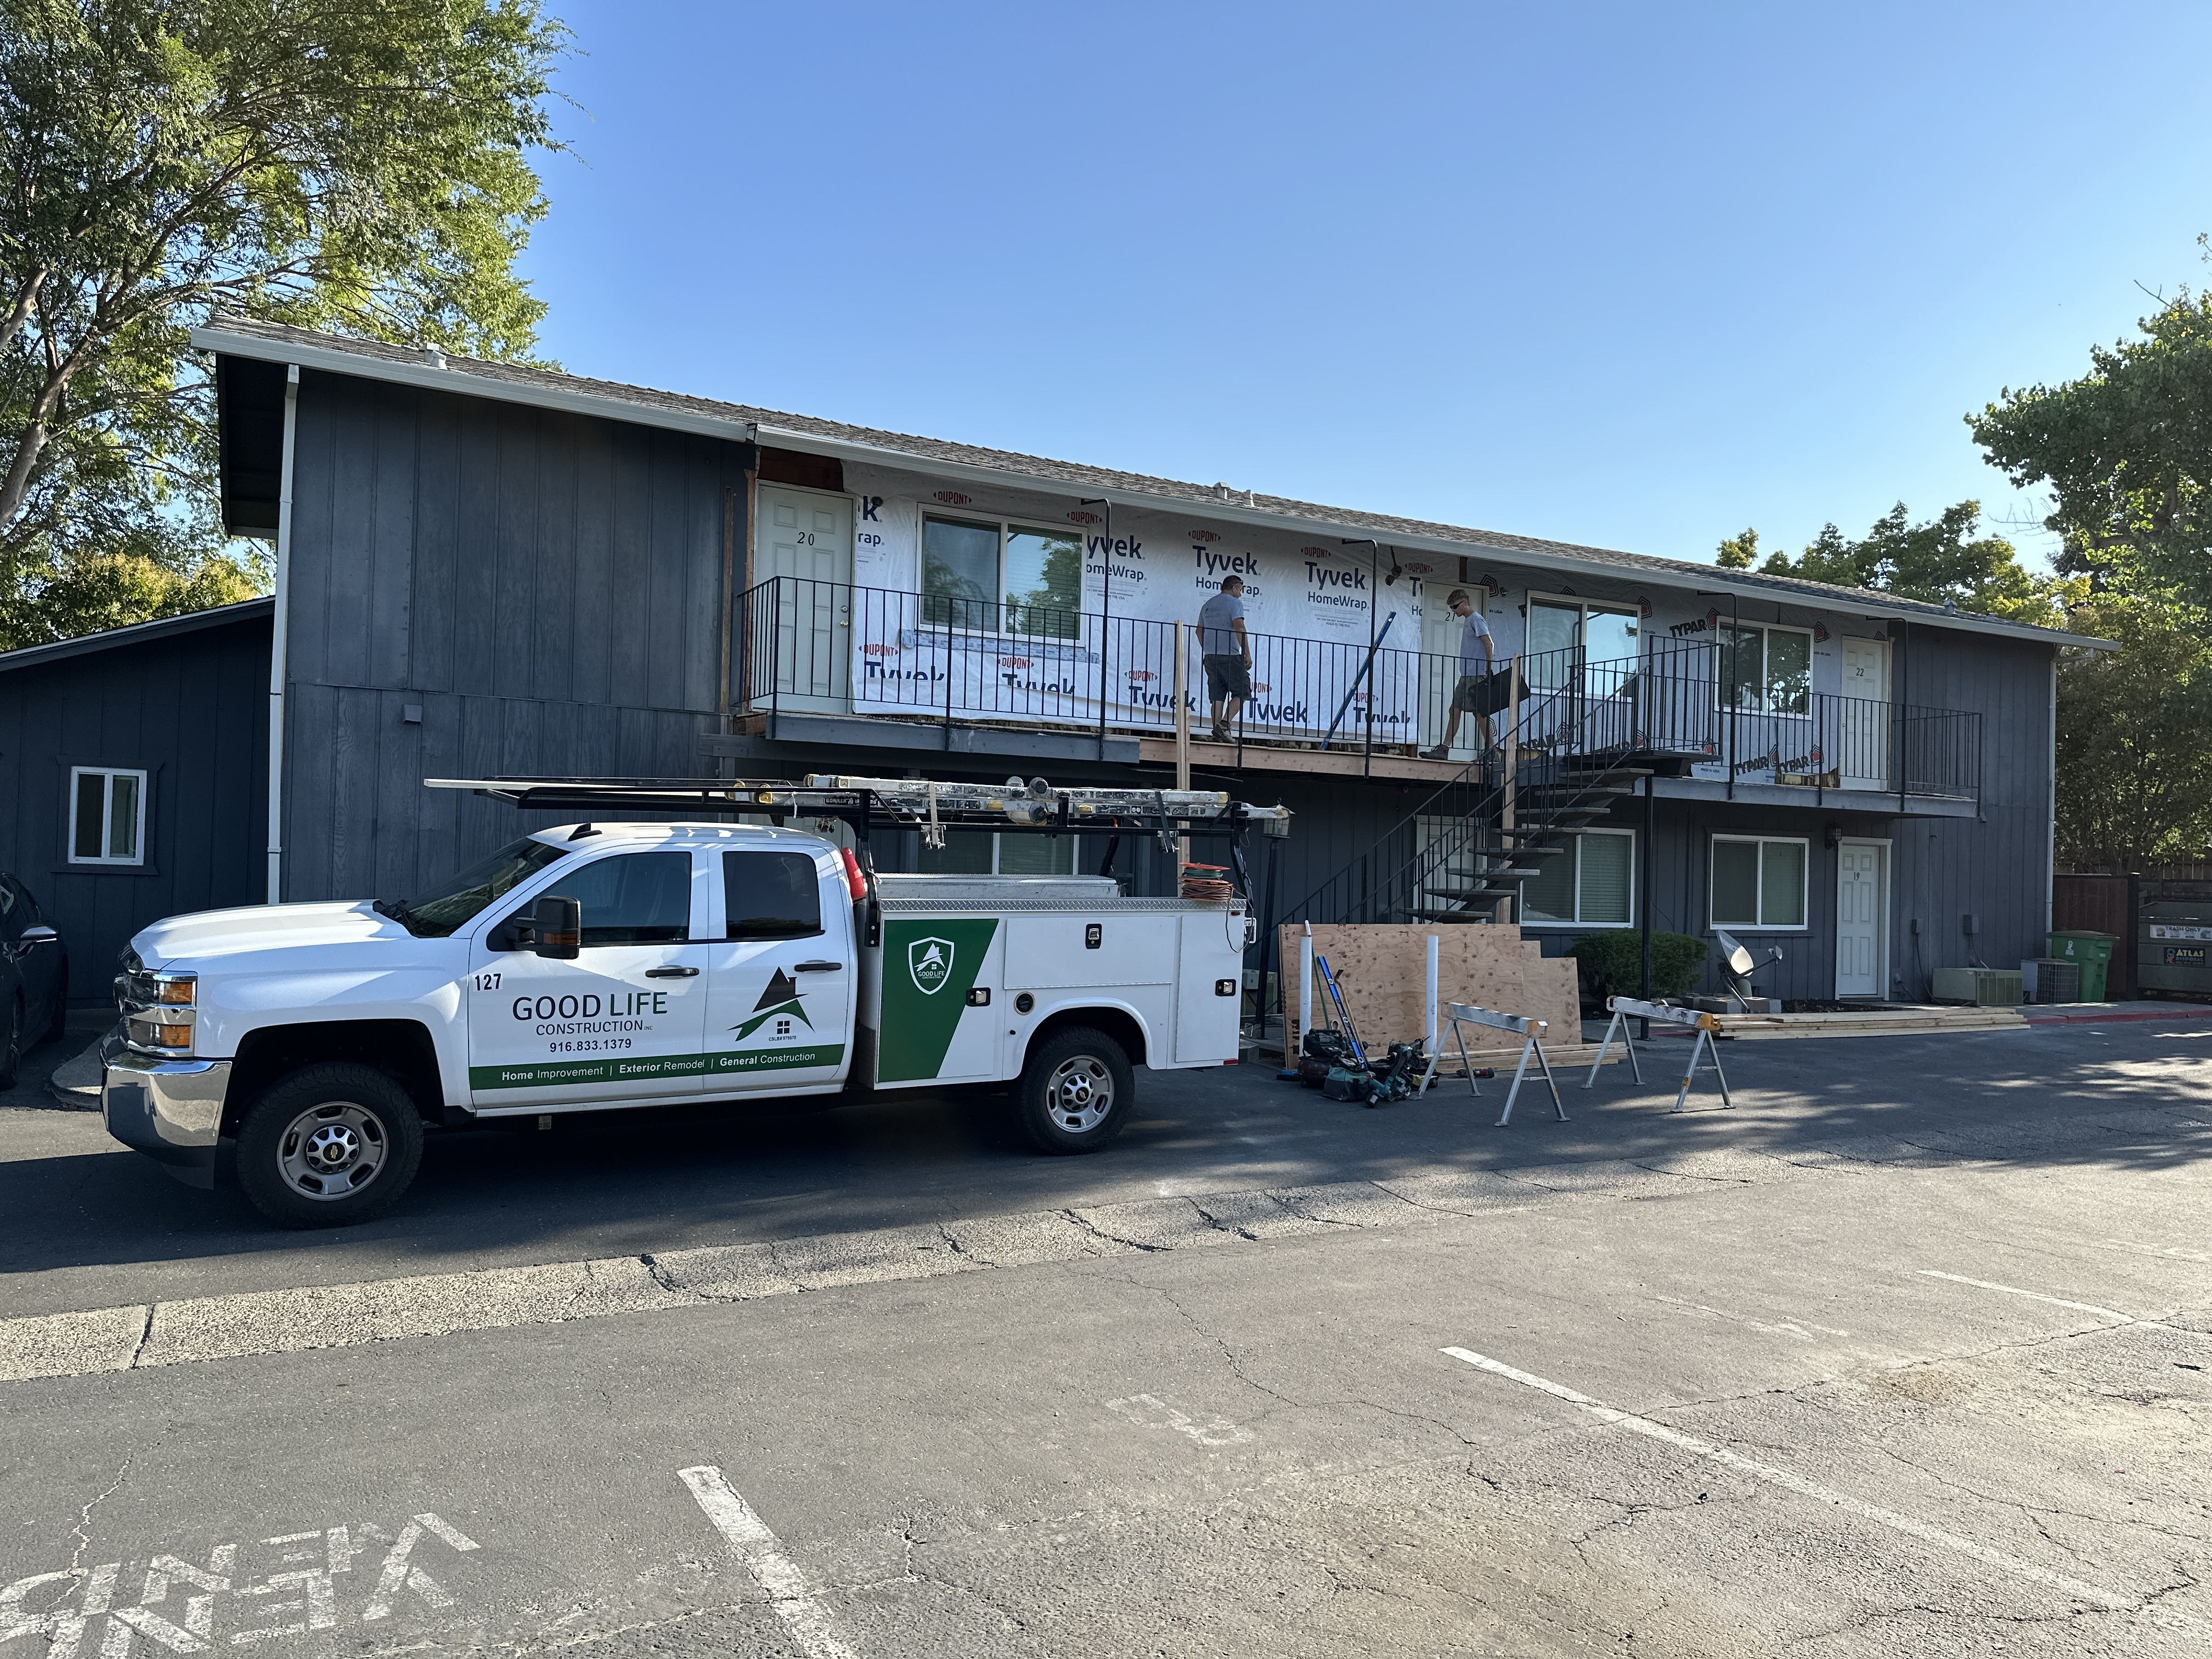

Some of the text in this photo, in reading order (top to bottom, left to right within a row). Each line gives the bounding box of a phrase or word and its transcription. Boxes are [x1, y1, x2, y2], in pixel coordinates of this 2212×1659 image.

[938, 490, 968, 504] DUPONT
[1071, 511, 1098, 524] DUPONT
[797, 532, 814, 546] 20
[1192, 530, 1218, 542] DUPONT
[1304, 547, 1328, 558] DUPONT
[1192, 545, 1257, 575] Tyvek
[1408, 562, 1430, 573] DUPONT
[1305, 561, 1366, 590] Tyvek
[1308, 591, 1367, 611] HomeWrap
[1669, 619, 1707, 638] TYPAR
[864, 644, 895, 657] DUPONT
[1002, 657, 1031, 669] DUPONT
[1128, 670, 1154, 682] DUPONT
[1856, 667, 1864, 676] 22
[1250, 681, 1269, 693] UPONT
[1353, 692, 1376, 703] DUPOT
[1854, 872, 1860, 881] 19
[2176, 949, 2204, 957] ATLAS
[475, 973, 501, 991] 127
[512, 991, 668, 1020] GOOD LIFE
[536, 1020, 643, 1035] CONSTRUCTION
[550, 1038, 631, 1052] 916.833.1379
[502, 1053, 815, 1081] Home Improvement Exterior Remodel General Construction
